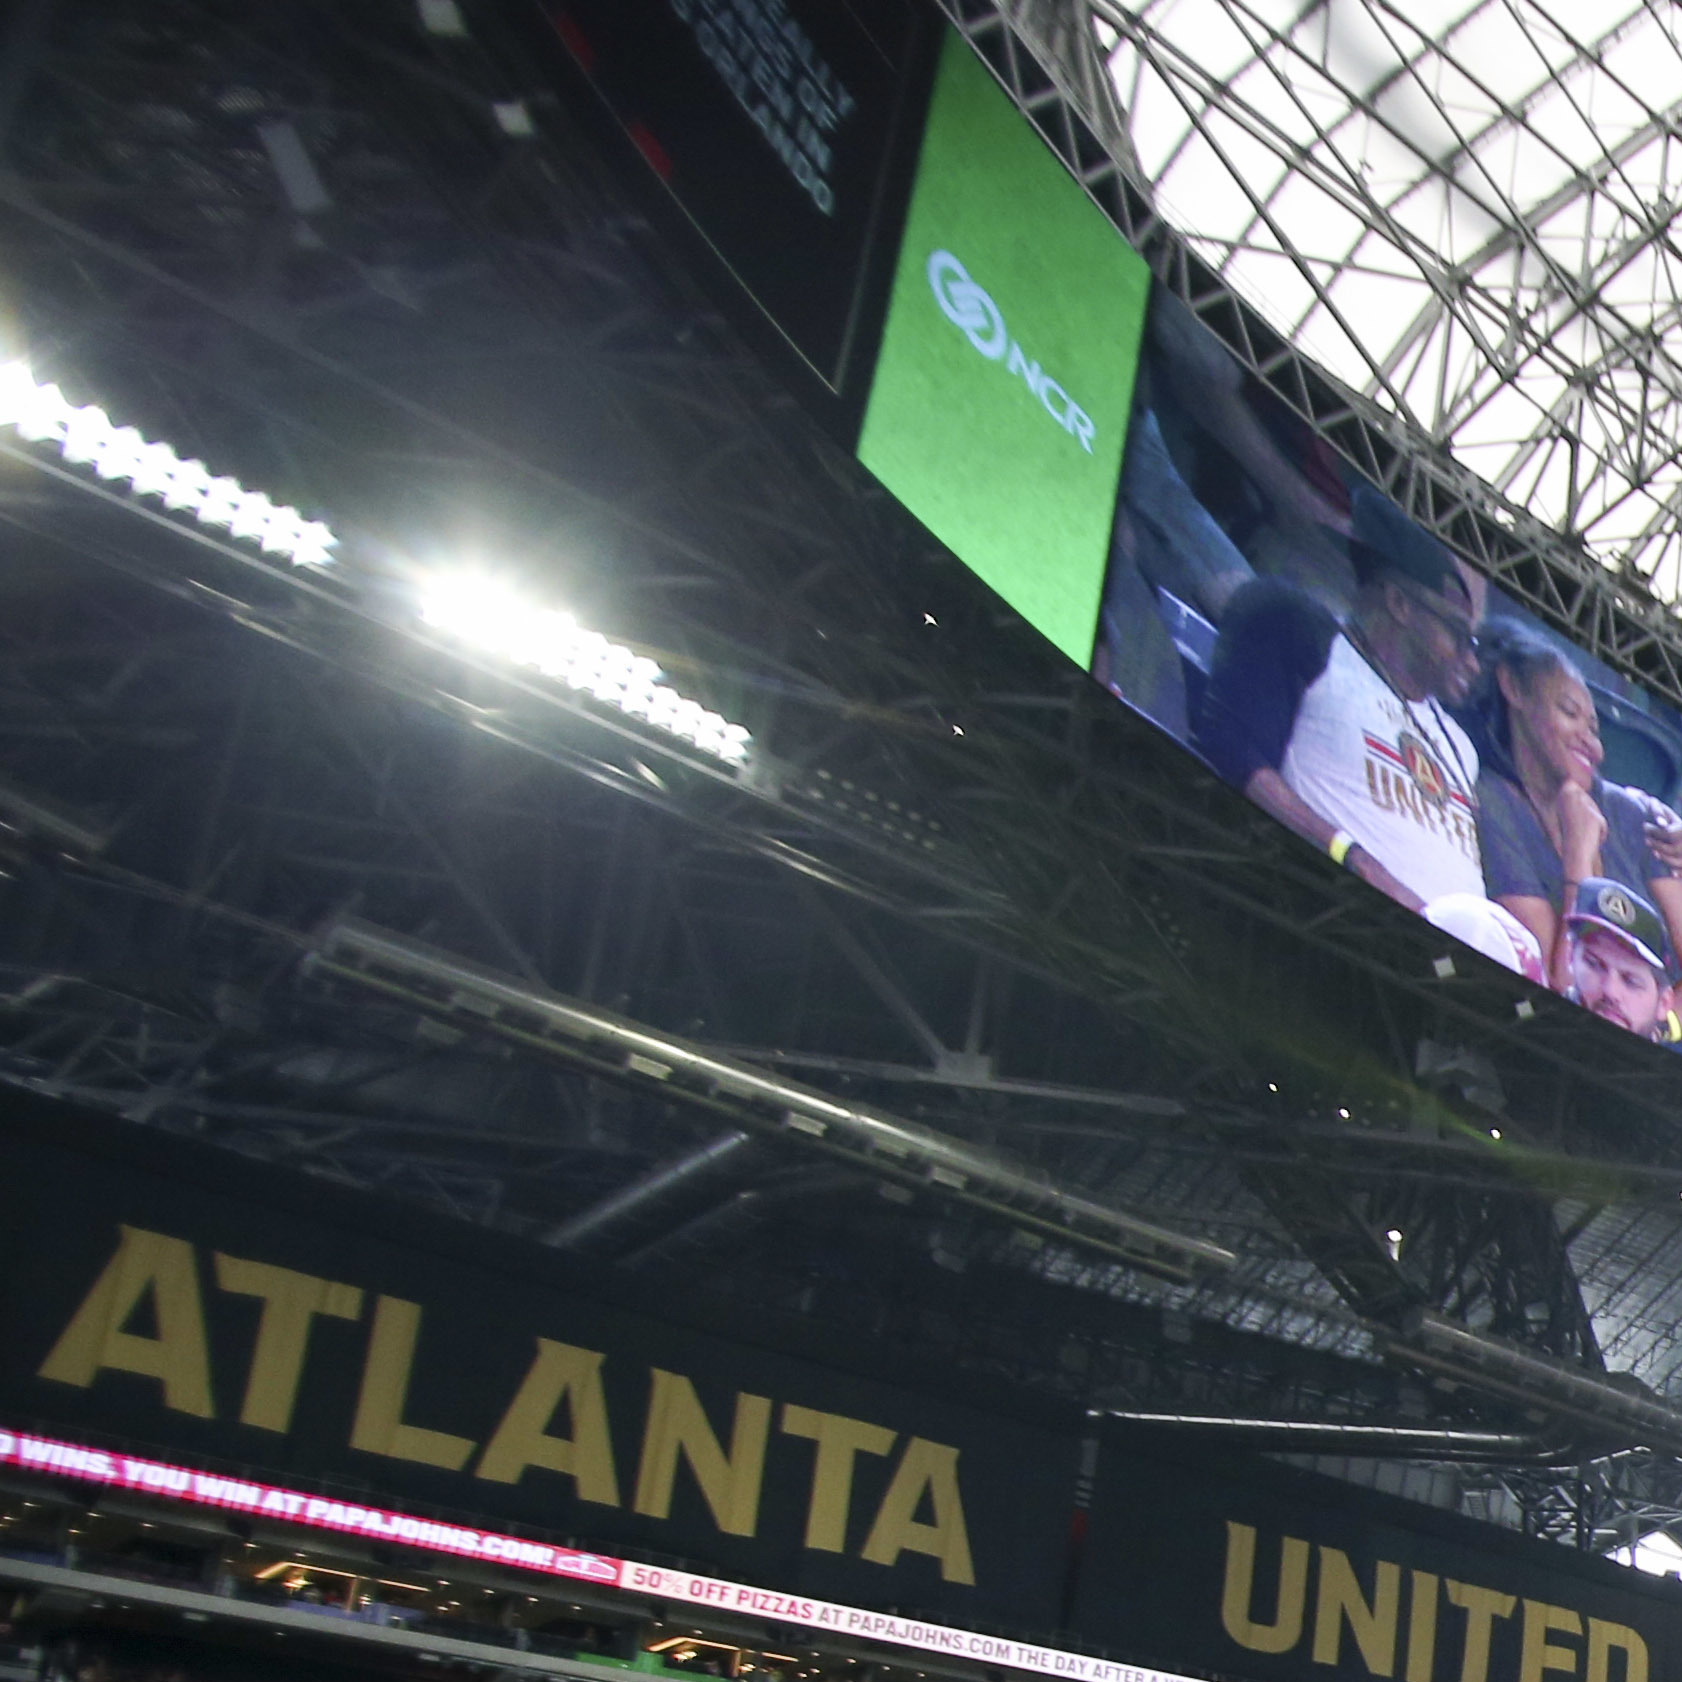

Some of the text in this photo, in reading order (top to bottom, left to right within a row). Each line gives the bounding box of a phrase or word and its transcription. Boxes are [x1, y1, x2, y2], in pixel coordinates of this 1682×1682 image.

[1008, 337, 1096, 457] NCR
[36, 1223, 977, 1587] ATLANTA
[19, 1436, 117, 1480] WINS,
[121, 1458, 192, 1492] YOU
[192, 1473, 263, 1505] WIN
[262, 1489, 308, 1516] AT
[306, 1498, 556, 1567] PAPAJOHNS.COM!
[633, 1566, 686, 1594] 50%
[689, 1579, 739, 1603] OFF
[738, 1588, 814, 1621] PIZZAS
[818, 1606, 843, 1626] AT
[847, 1611, 1011, 1660] PAPAJOHNS.COM
[1016, 1646, 1049, 1669] THE
[1054, 1654, 1088, 1677] DAY
